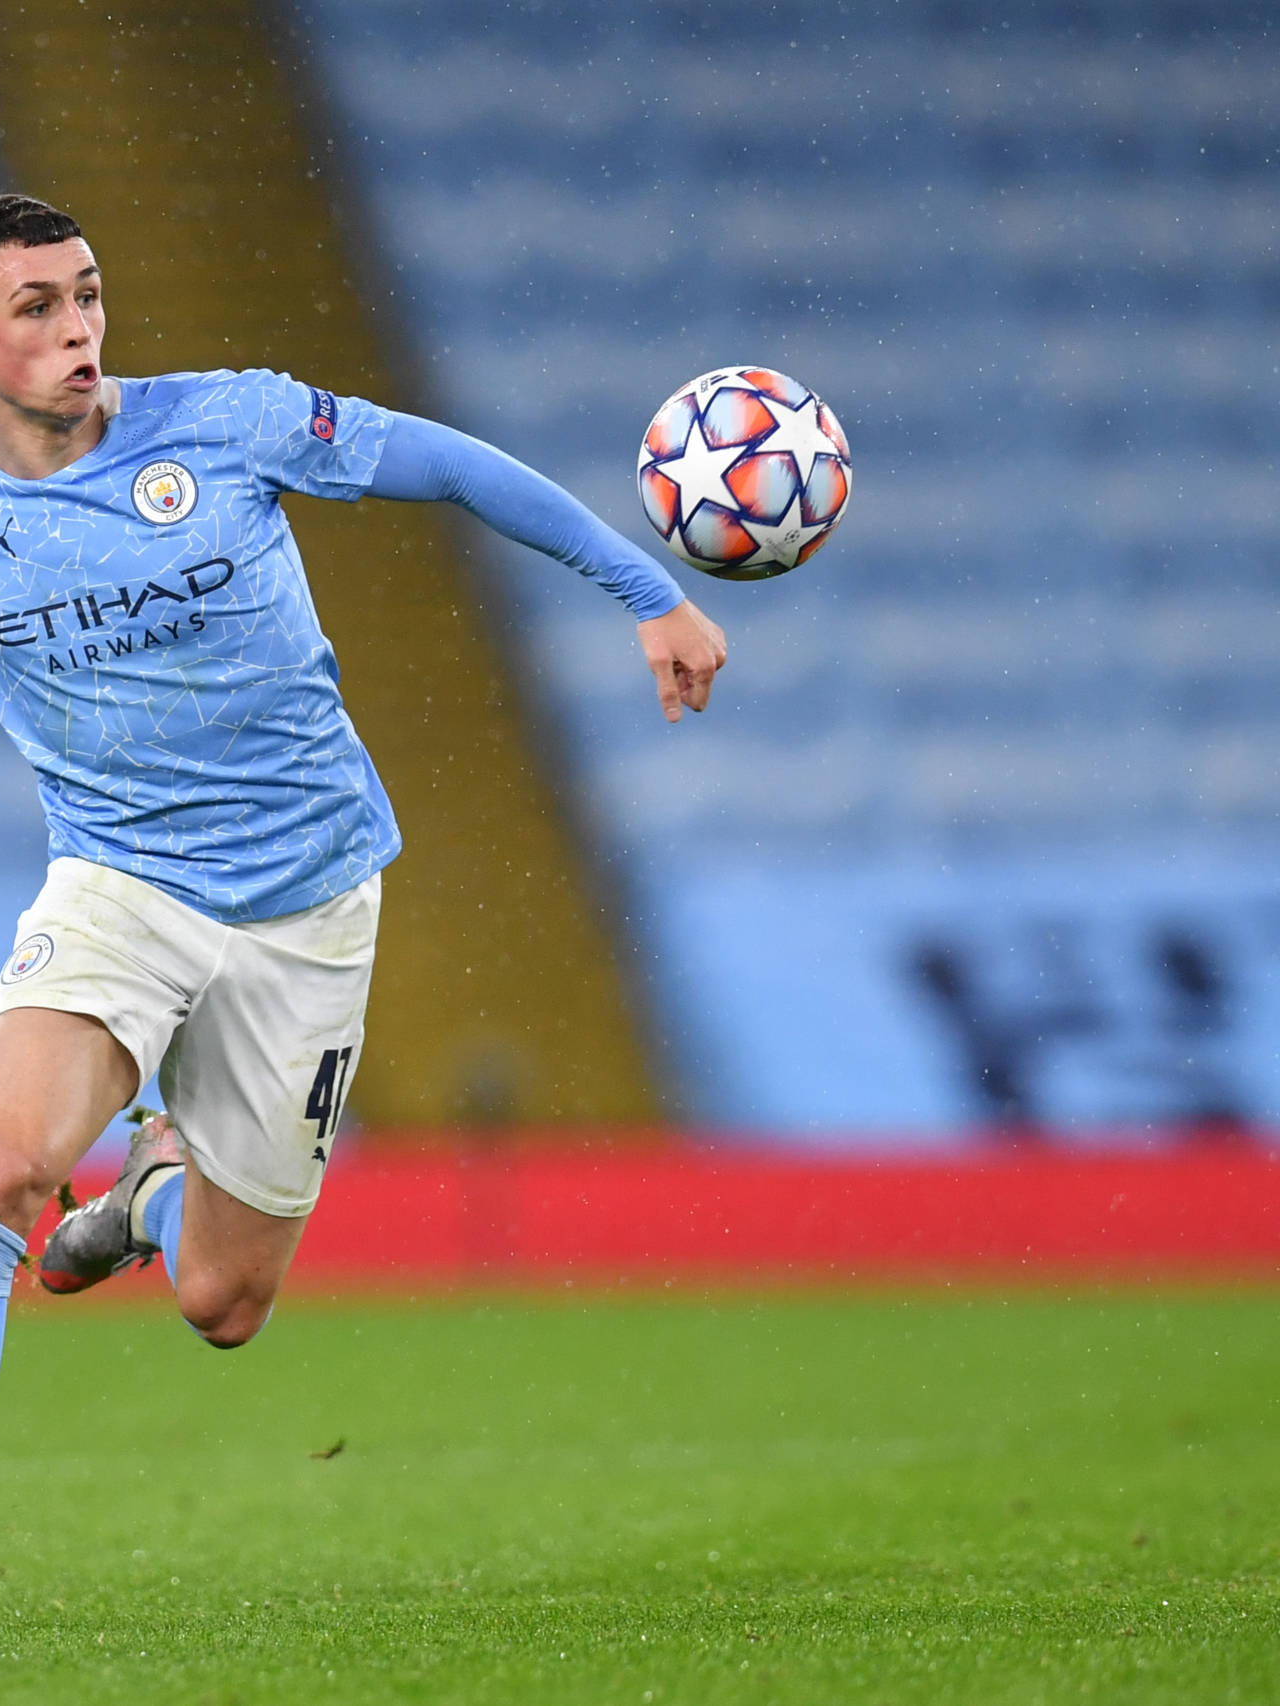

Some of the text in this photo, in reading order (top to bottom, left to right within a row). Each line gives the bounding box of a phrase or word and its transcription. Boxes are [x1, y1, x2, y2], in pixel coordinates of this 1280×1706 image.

[136, 464, 185, 494] MANCHESTER
[165, 509, 184, 521] CITY
[48, 612, 206, 675] AIRWAYS
[304, 1045, 353, 1140] 41
